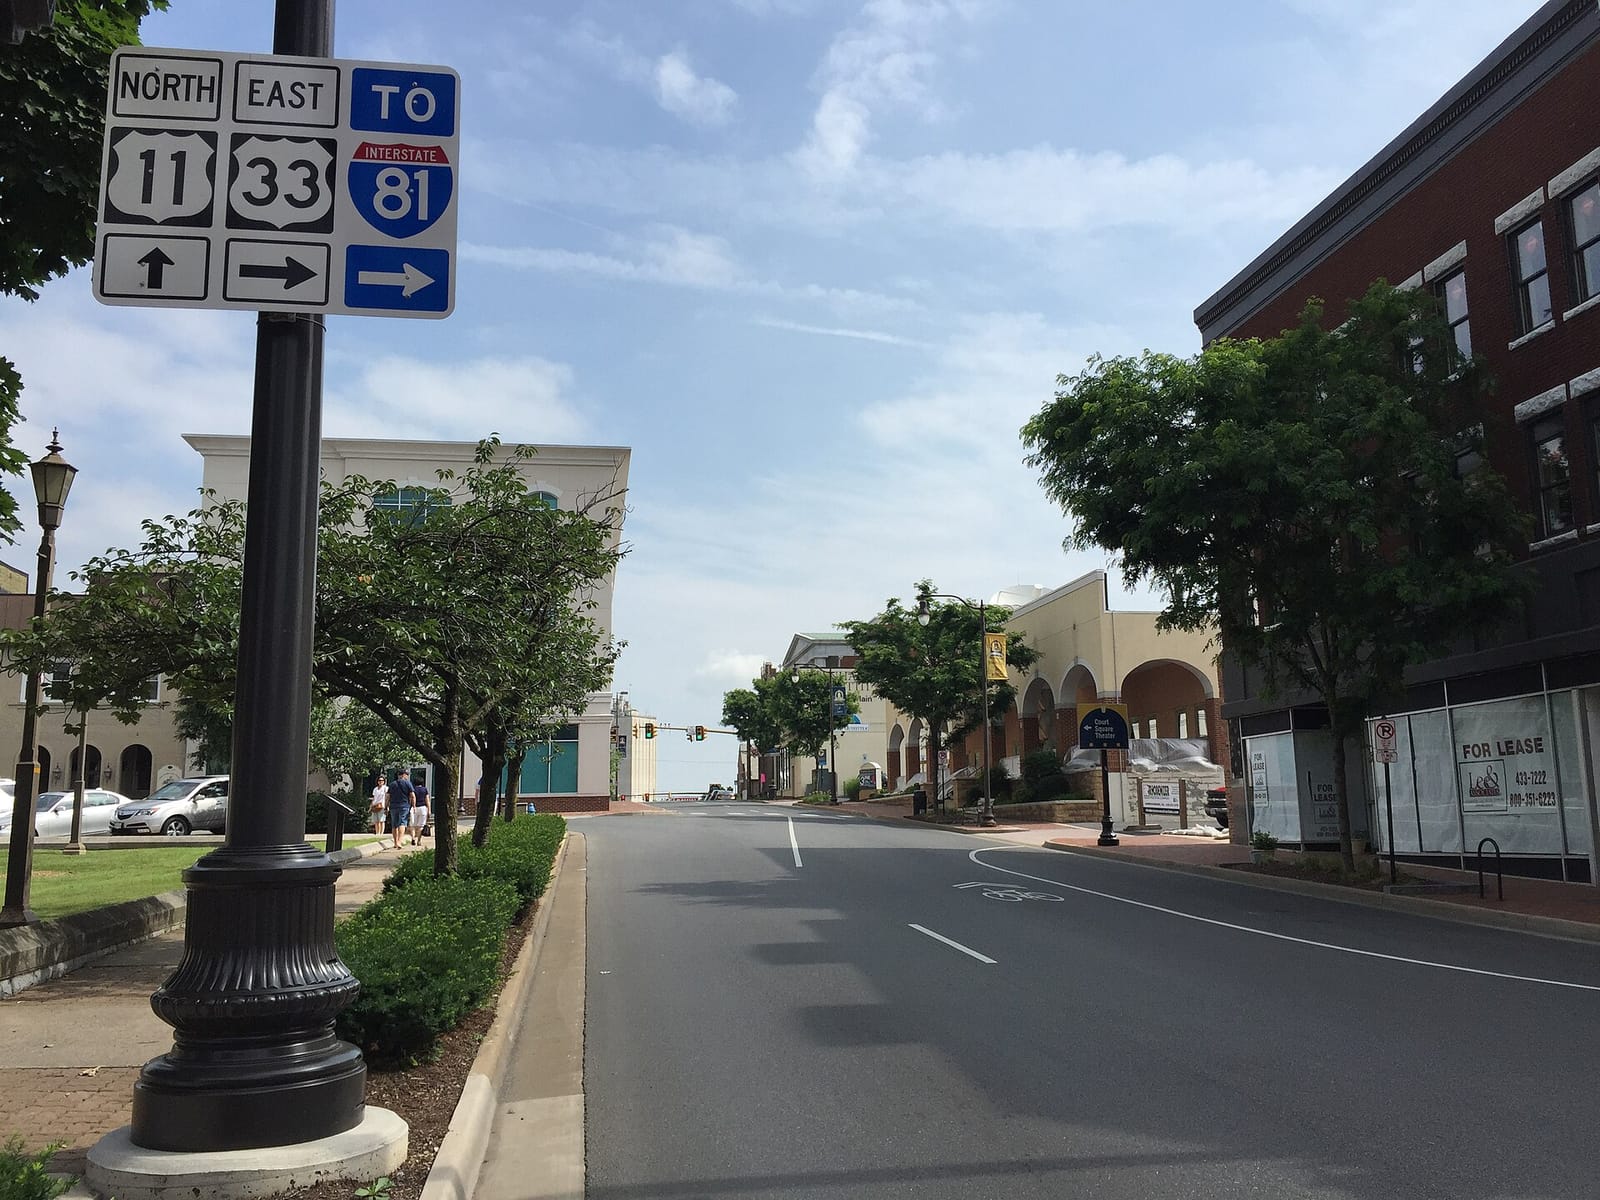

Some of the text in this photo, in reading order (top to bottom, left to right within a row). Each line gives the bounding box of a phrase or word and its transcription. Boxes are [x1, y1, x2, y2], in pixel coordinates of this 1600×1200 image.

[120, 71, 216, 103] NORTH
[248, 78, 324, 110] EAST
[371, 84, 436, 123] TO
[365, 146, 437, 162] INTERSTATE
[139, 149, 187, 206] 11
[241, 157, 321, 209] 33
[373, 167, 429, 222] 81
[1094, 725, 1114, 733] Square
[1463, 737, 1544, 759] FOR LEASE
[1317, 784, 1333, 792] FOR
[1515, 770, 1547, 785] 433-7222
[1314, 793, 1337, 802] LEASE
[1509, 792, 1556, 807] 800-351-6223
